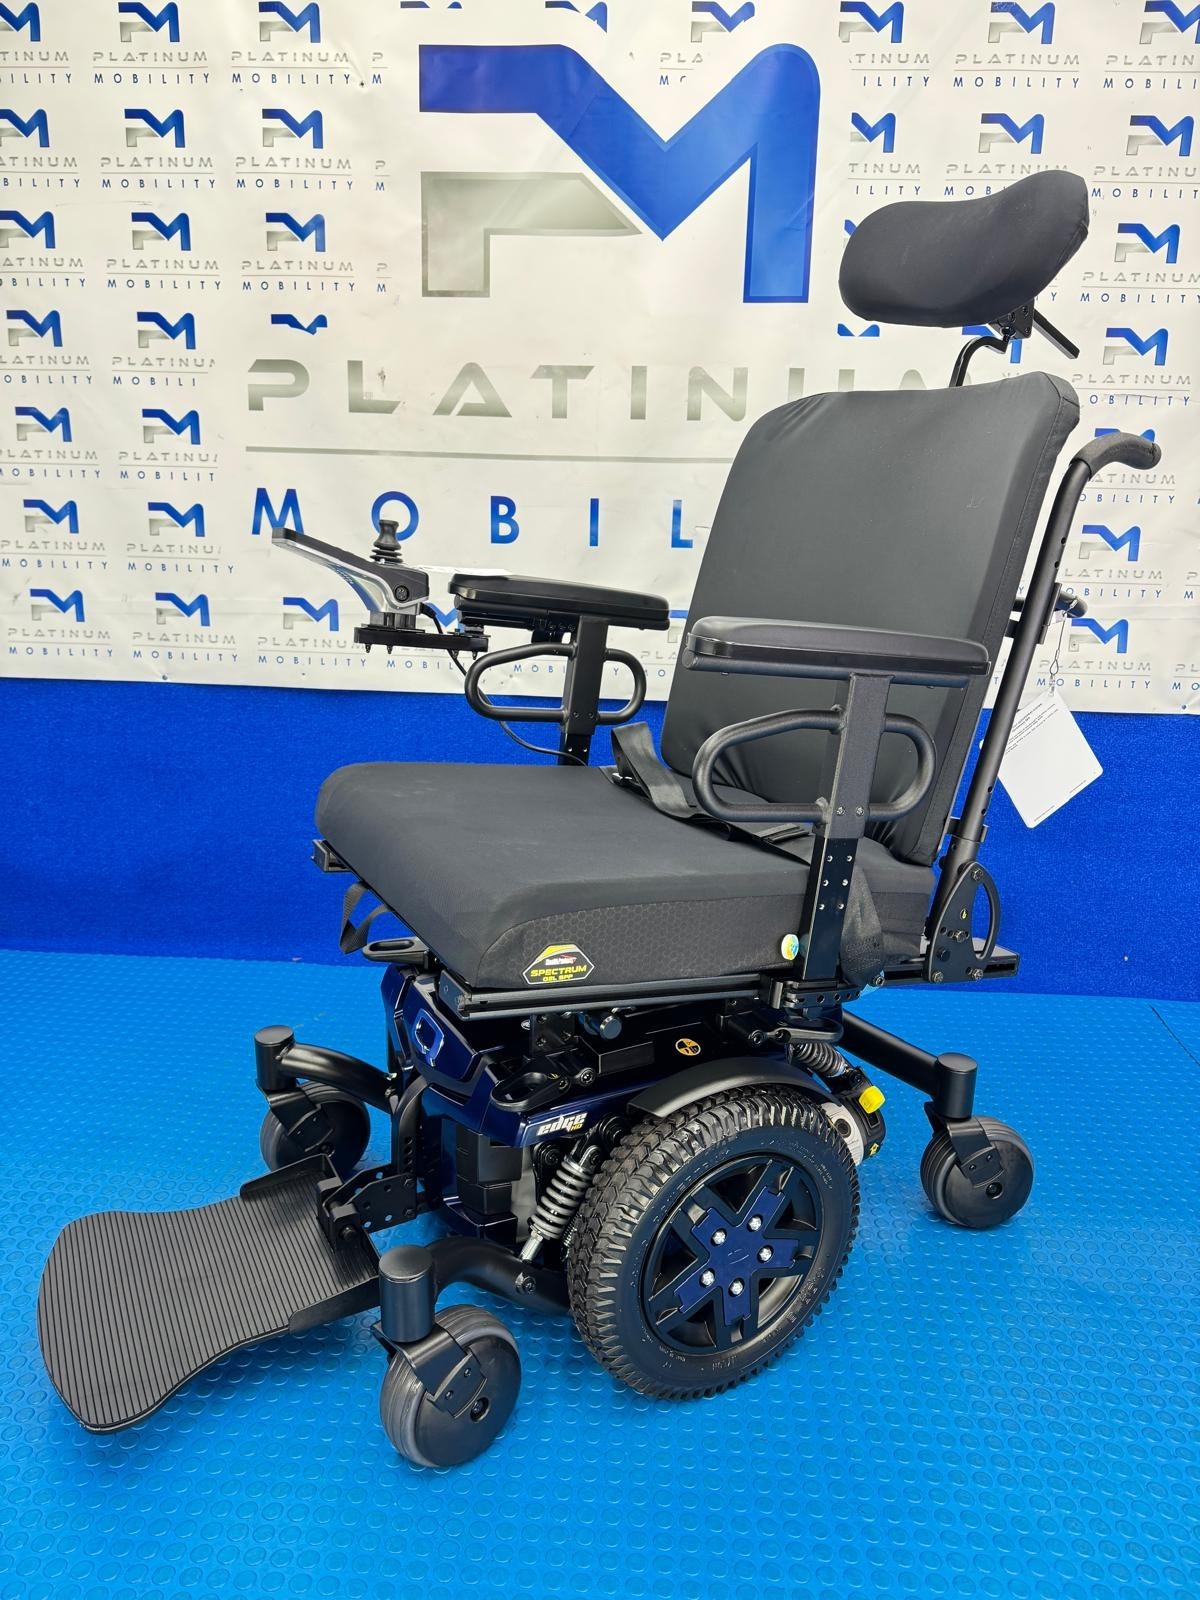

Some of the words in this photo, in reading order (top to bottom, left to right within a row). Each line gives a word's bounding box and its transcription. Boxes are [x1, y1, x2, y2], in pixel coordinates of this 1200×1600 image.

[93, 52, 207, 62] PLATINUM
[232, 51, 349, 62] PLATINUM
[849, 53, 929, 63] TINUM
[955, 54, 1079, 65] PLATINUM
[0, 73, 71, 83] ILITY
[94, 73, 209, 84] MOBILITY
[232, 73, 349, 84] MOBILITY
[954, 77, 1079, 88] MOBILITY
[101, 157, 212, 167] PLATINUM
[236, 157, 351, 169] PLATINUM
[102, 179, 215, 188] MOBILITY
[237, 179, 352, 189] MOBILITY
[107, 259, 218, 269] PLATINUM
[242, 261, 353, 271] PLATINUM
[108, 280, 220, 289] MOBILITY
[243, 281, 354, 291] MOBILITY
[1071, 374, 1191, 385] PLATINUM
[1090, 394, 1189, 405] OBILITY
[1090, 473, 1175, 484] ATINUM
[1080, 494, 1174, 503] OBILITY
[1, 540, 105, 553] PLATINUM
[2, 559, 107, 569] MOBILITY
[128, 563, 233, 573] MOBILITY
[1065, 569, 1163, 580] LATINUM
[1066, 588, 1162, 598] OBILITY
[8, 628, 110, 639] PLATINUM
[133, 632, 235, 646] PLATINUM
[9, 647, 112, 657] MOBILITY
[133, 651, 237, 661] MOBILITY
[259, 656, 366, 666] MOBILITY
[1037, 678, 1150, 688] MOBILITY
[530, 964, 587, 977] SPECTRUM
[536, 1112, 588, 1136] edge
